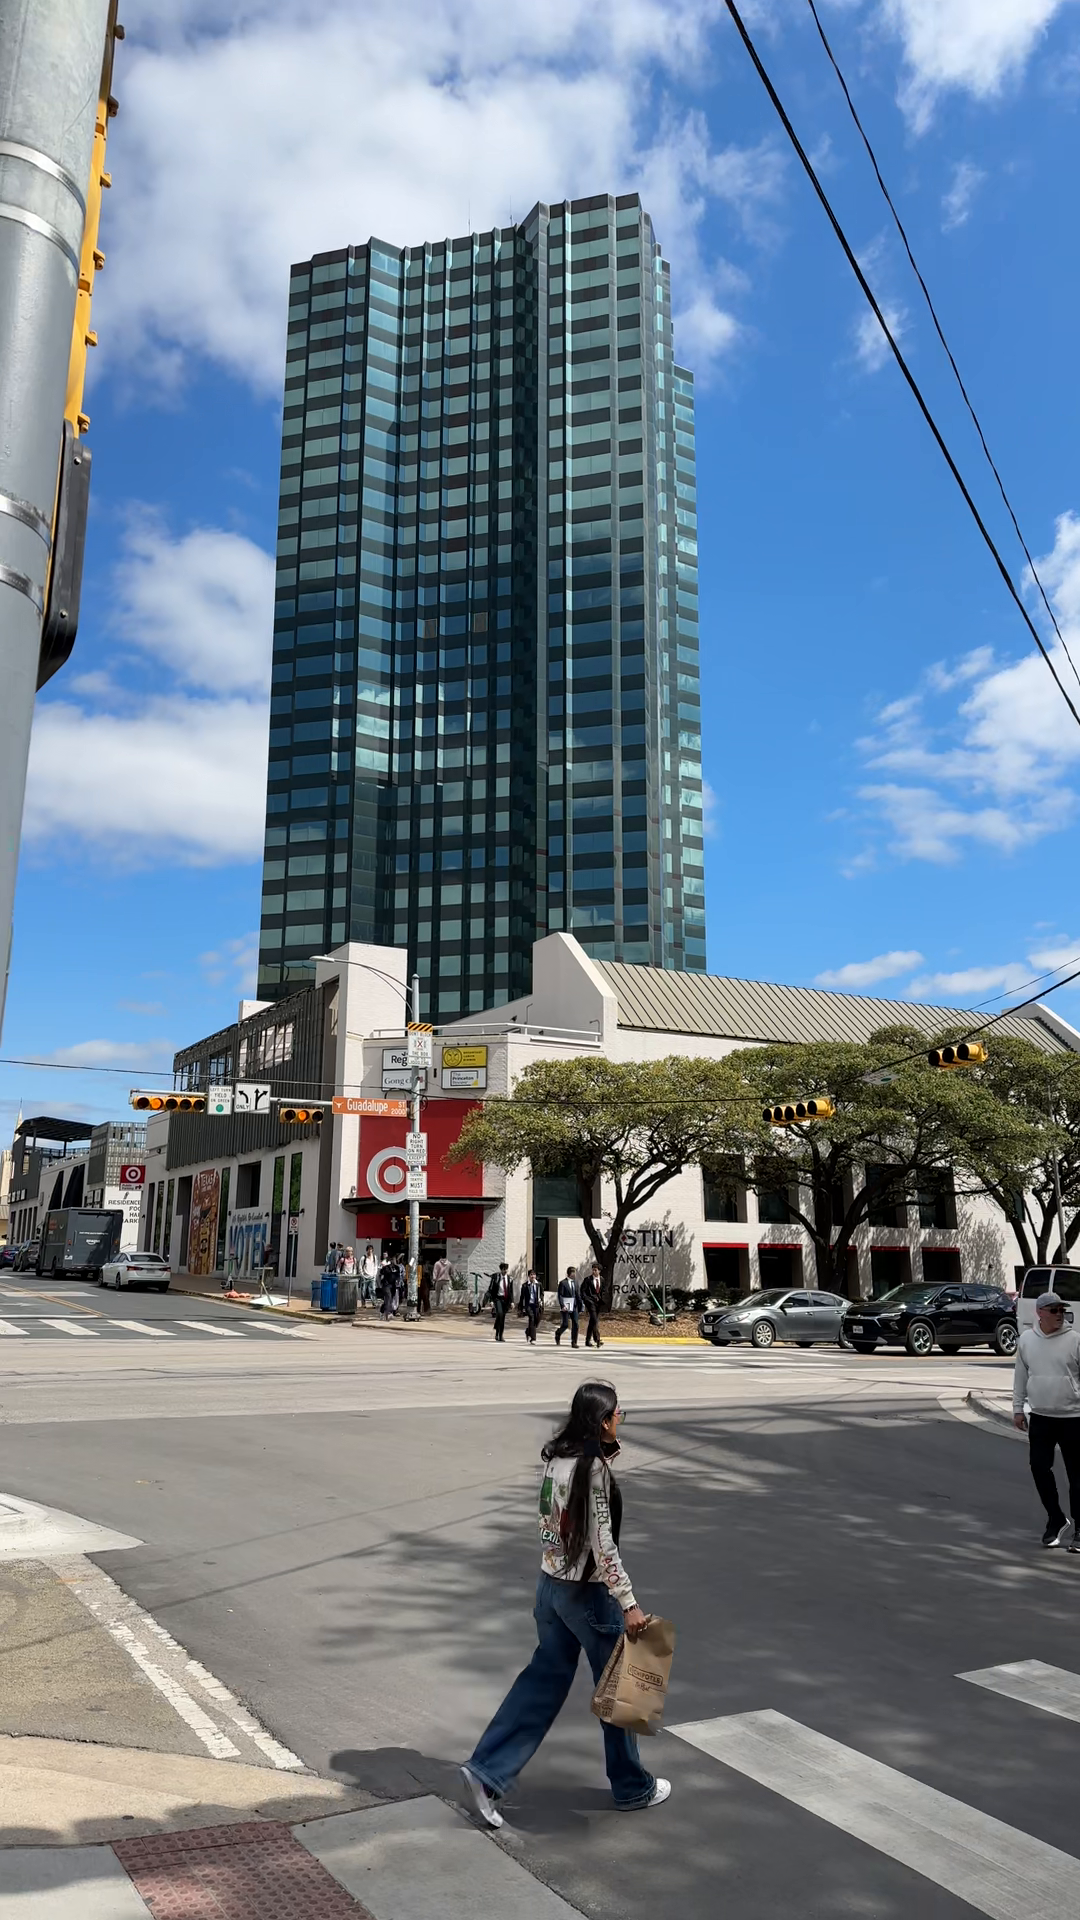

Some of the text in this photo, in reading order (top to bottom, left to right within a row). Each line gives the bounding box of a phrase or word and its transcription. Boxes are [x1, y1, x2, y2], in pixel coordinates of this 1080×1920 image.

[384, 1077, 404, 1085] Gong
[347, 1098, 388, 1114] Guadalupe
[615, 1254, 657, 1264] ARKET
[630, 1269, 638, 1279] &
